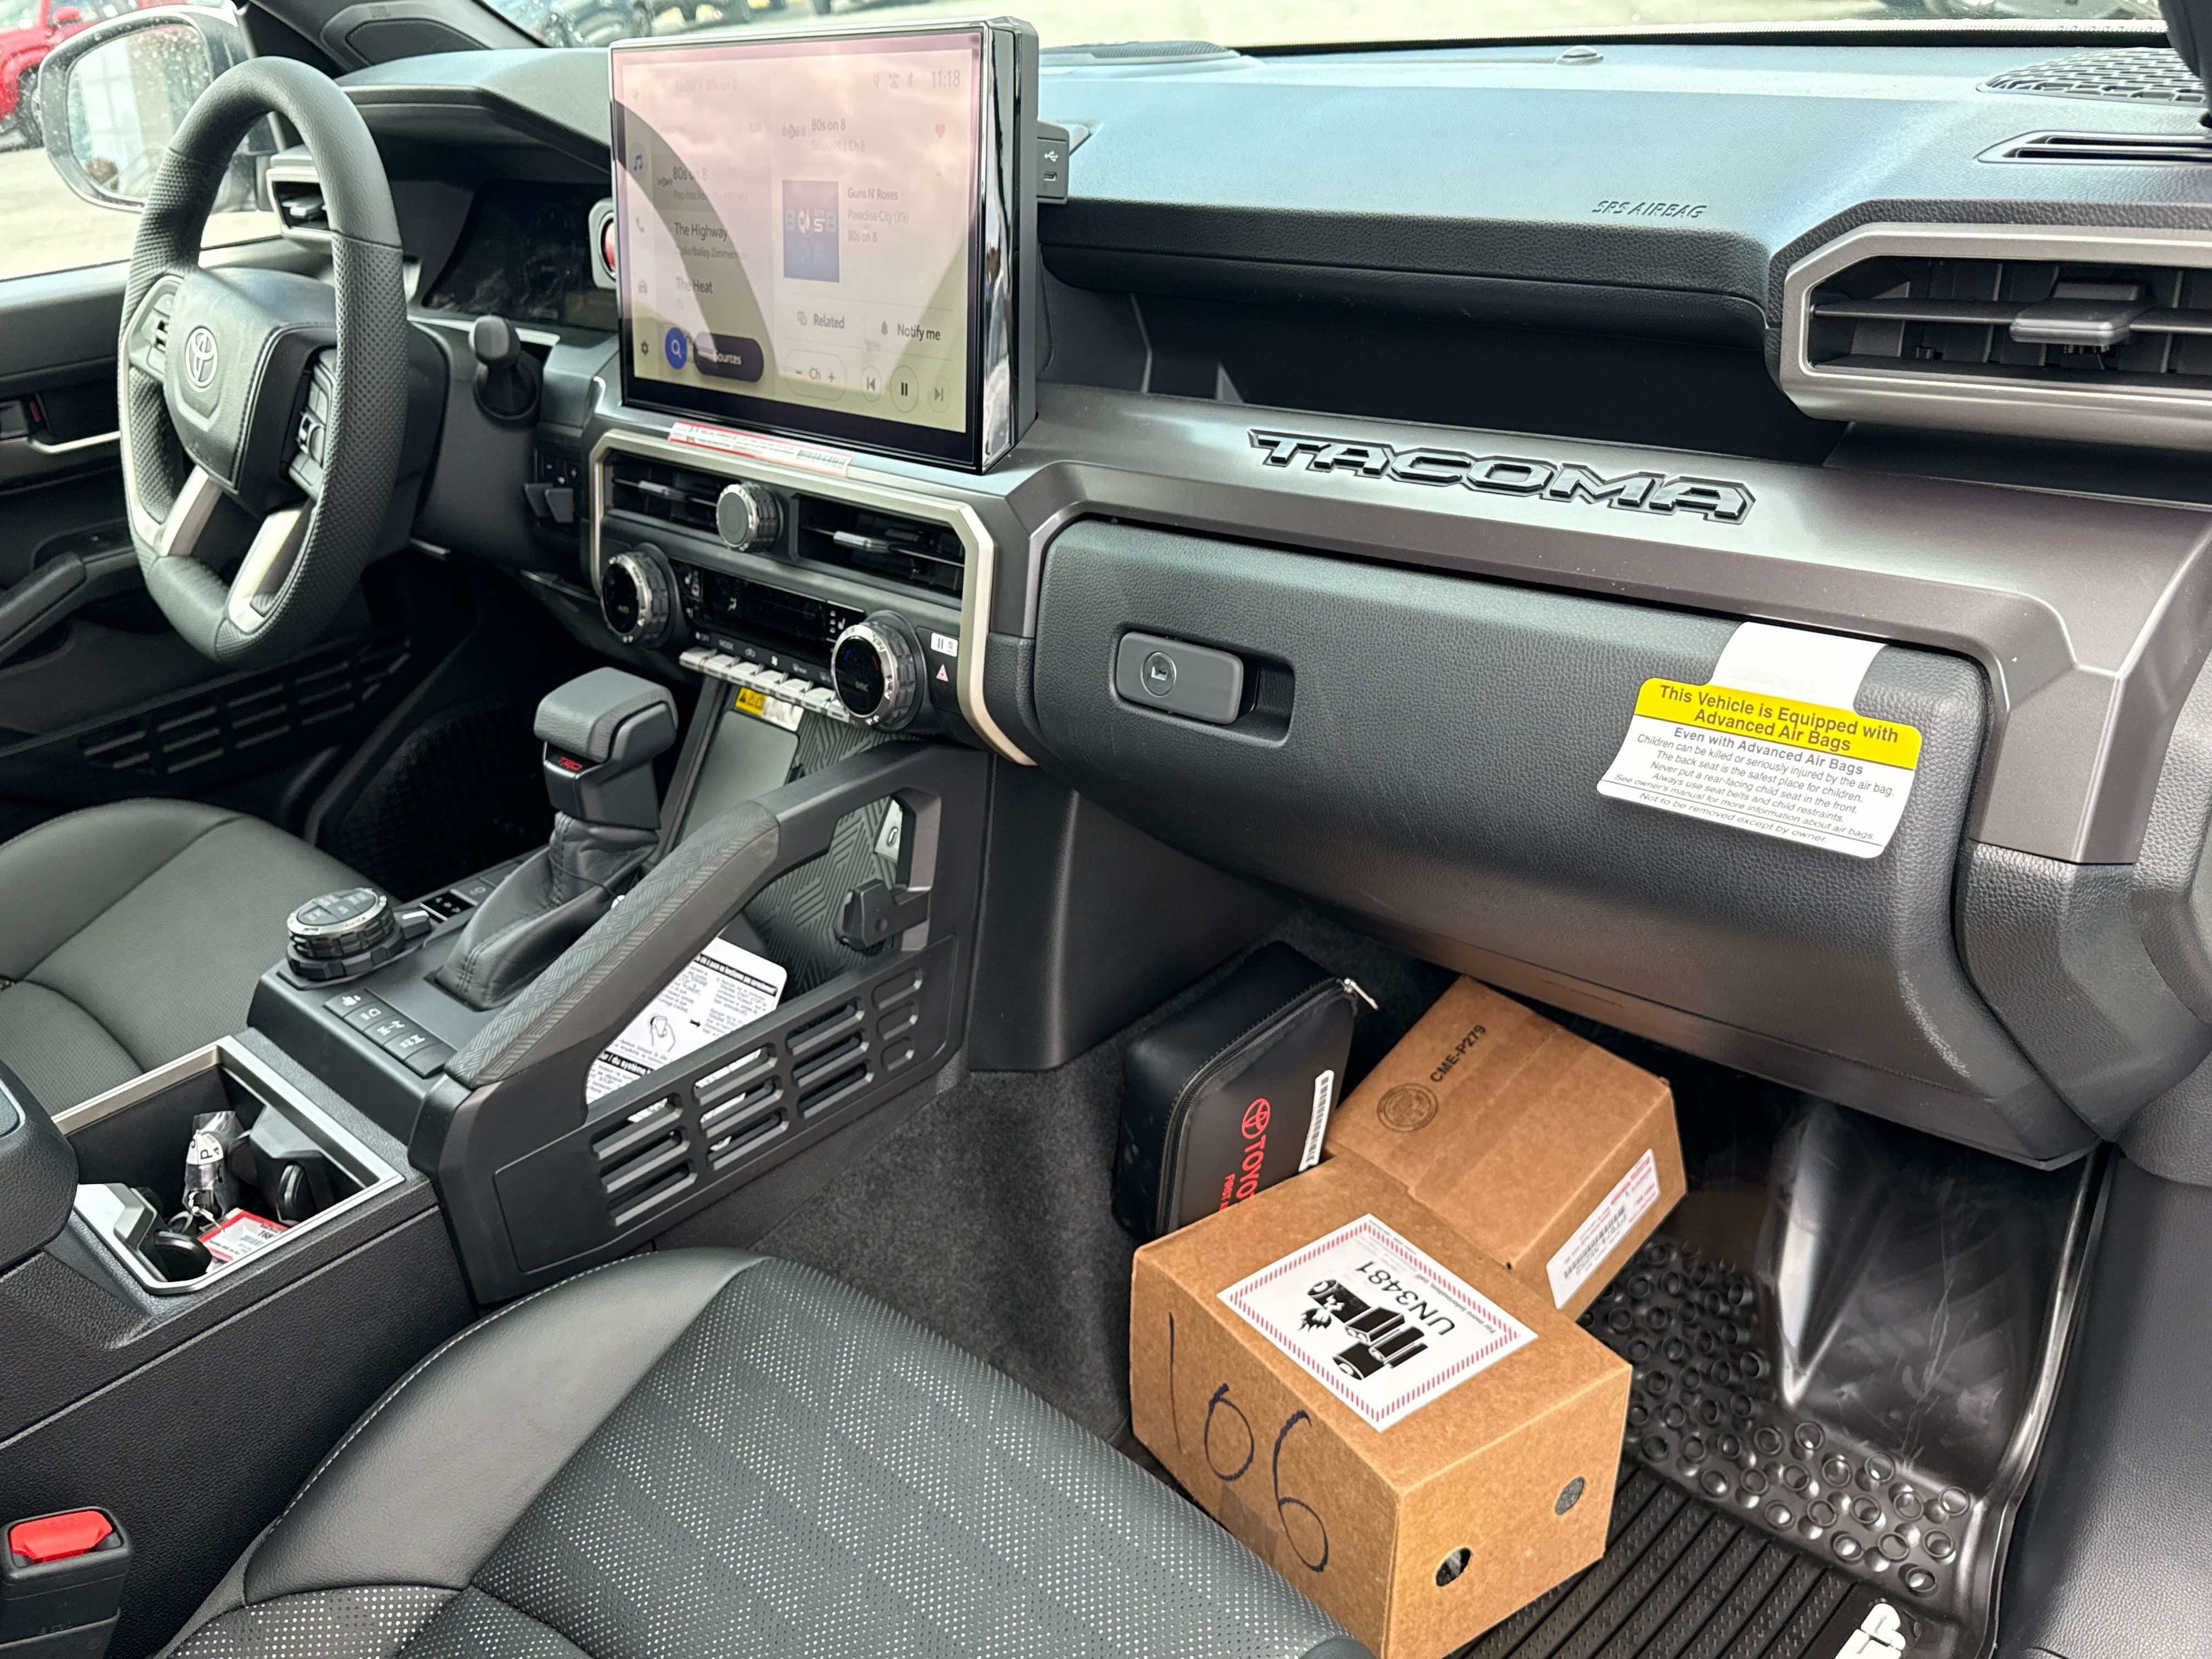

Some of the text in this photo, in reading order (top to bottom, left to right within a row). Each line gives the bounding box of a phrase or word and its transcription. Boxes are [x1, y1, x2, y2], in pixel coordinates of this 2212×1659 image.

[931, 70, 961, 88] 11:18
[811, 118, 826, 132] 80s
[827, 121, 839, 132] on
[673, 167, 687, 180] 80s
[848, 188, 867, 199] Guns
[877, 189, 899, 201] Roses
[1592, 200, 1707, 218] SRS AIRBAG
[674, 222, 728, 242] The Highway
[693, 280, 713, 294] Heat
[813, 314, 844, 329] Related
[897, 323, 941, 341] Notify me
[809, 368, 821, 380] Ch
[1248, 428, 1756, 524] TACOMA
[1660, 684, 1899, 743] This Vehicle is Equipped with
[1694, 708, 1851, 752] Advanced Air Bags
[556, 755, 584, 771] TRD
[1637, 733, 1894, 798] Children can be killed or seriously injured by the air bag.
[1674, 727, 1864, 776] Even with Advanced Air Bags
[1650, 760, 1678, 774] Never
[1678, 768, 1695, 778] put
[1703, 774, 1754, 792] rear-facing
[1756, 785, 1780, 797] child
[1780, 790, 1802, 802] seat
[1803, 794, 1813, 804] in
[1814, 797, 1831, 808] the
[1832, 802, 1858, 814] front.
[1656, 750, 1863, 803] The back seat is the safest place for children.
[1615, 774, 1875, 840] See owner's manual for more information about air bags.
[1651, 772, 1844, 823] Always use seat belts and child restraints.
[1639, 792, 1828, 844] Not to be removed except by owner.
[1430, 1024, 1486, 1082] CME-P279
[1235, 1134, 1266, 1199] TOYO
[1356, 1261, 1455, 1335] UN3481
[1429, 1283, 1468, 1313] information,
[1466, 1312, 1482, 1323] more
[1481, 1322, 1497, 1334] For
